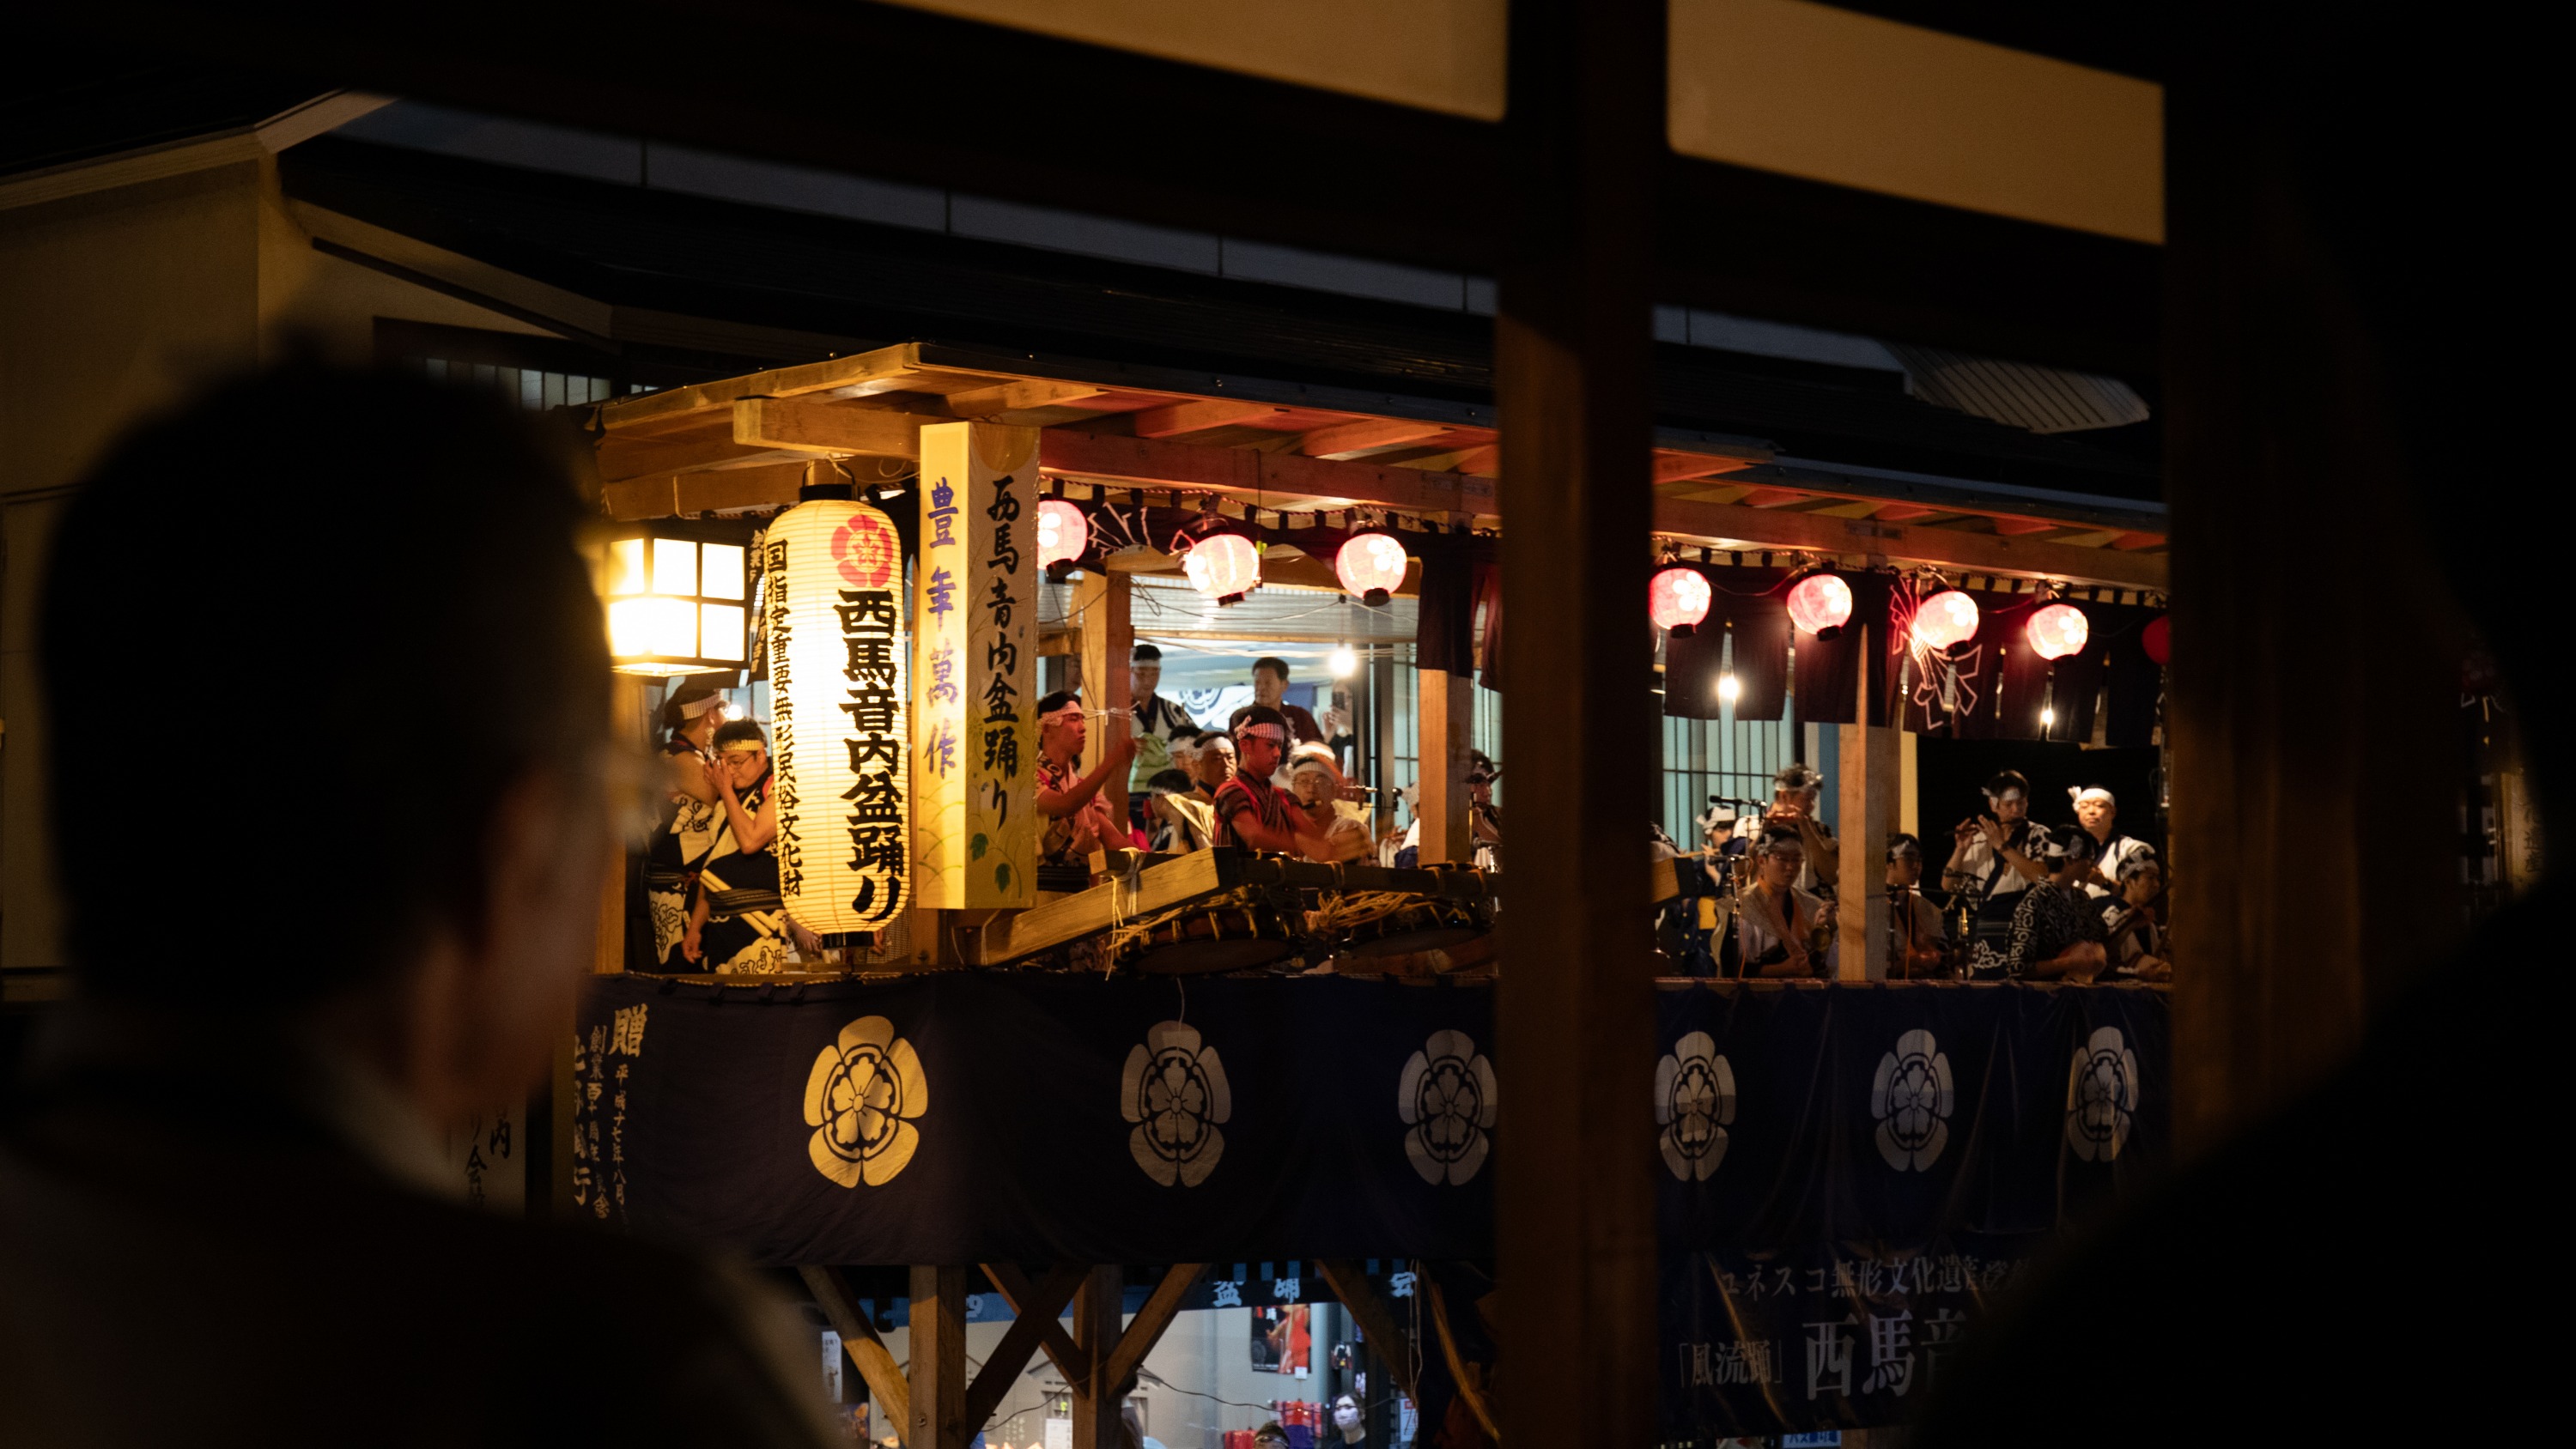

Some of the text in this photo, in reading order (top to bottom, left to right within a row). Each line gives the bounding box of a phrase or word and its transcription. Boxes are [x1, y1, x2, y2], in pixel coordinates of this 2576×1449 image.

[833, 589, 904, 922] 西馬音内盆踊り
[923, 476, 959, 779] 豊年萬作
[983, 475, 1020, 831] 西馬音内盆踊り
